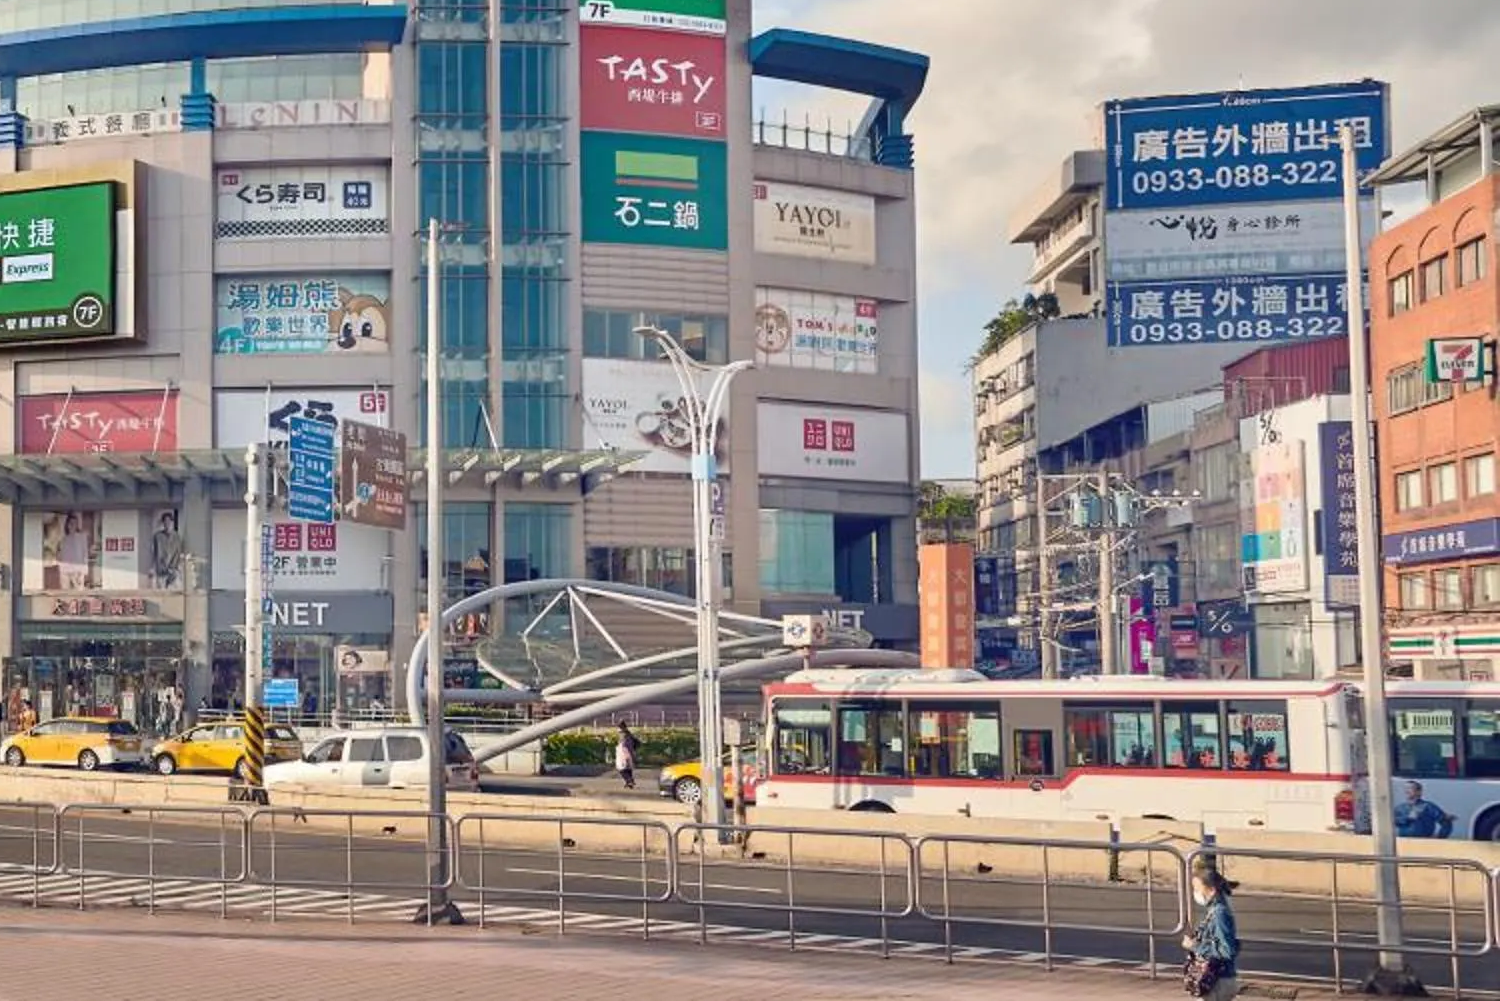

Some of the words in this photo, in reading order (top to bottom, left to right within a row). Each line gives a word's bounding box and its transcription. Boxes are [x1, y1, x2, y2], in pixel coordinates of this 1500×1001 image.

[588, 2, 611, 18] 7F
[1132, 116, 1373, 162] 廣告外牆出租
[1132, 160, 1337, 195] 0933-088-322
[236, 183, 326, 204] くら寿司
[614, 196, 699, 230] 石二鍋
[775, 202, 841, 229] YAYOI
[5, 261, 49, 278] Express
[227, 280, 339, 310] 湯姆熊
[78, 304, 98, 320] 7F
[243, 315, 327, 336] 歡樂世界
[1130, 316, 1343, 344] 0933-088-322
[271, 601, 329, 626] NET
[822, 609, 865, 630] NET
